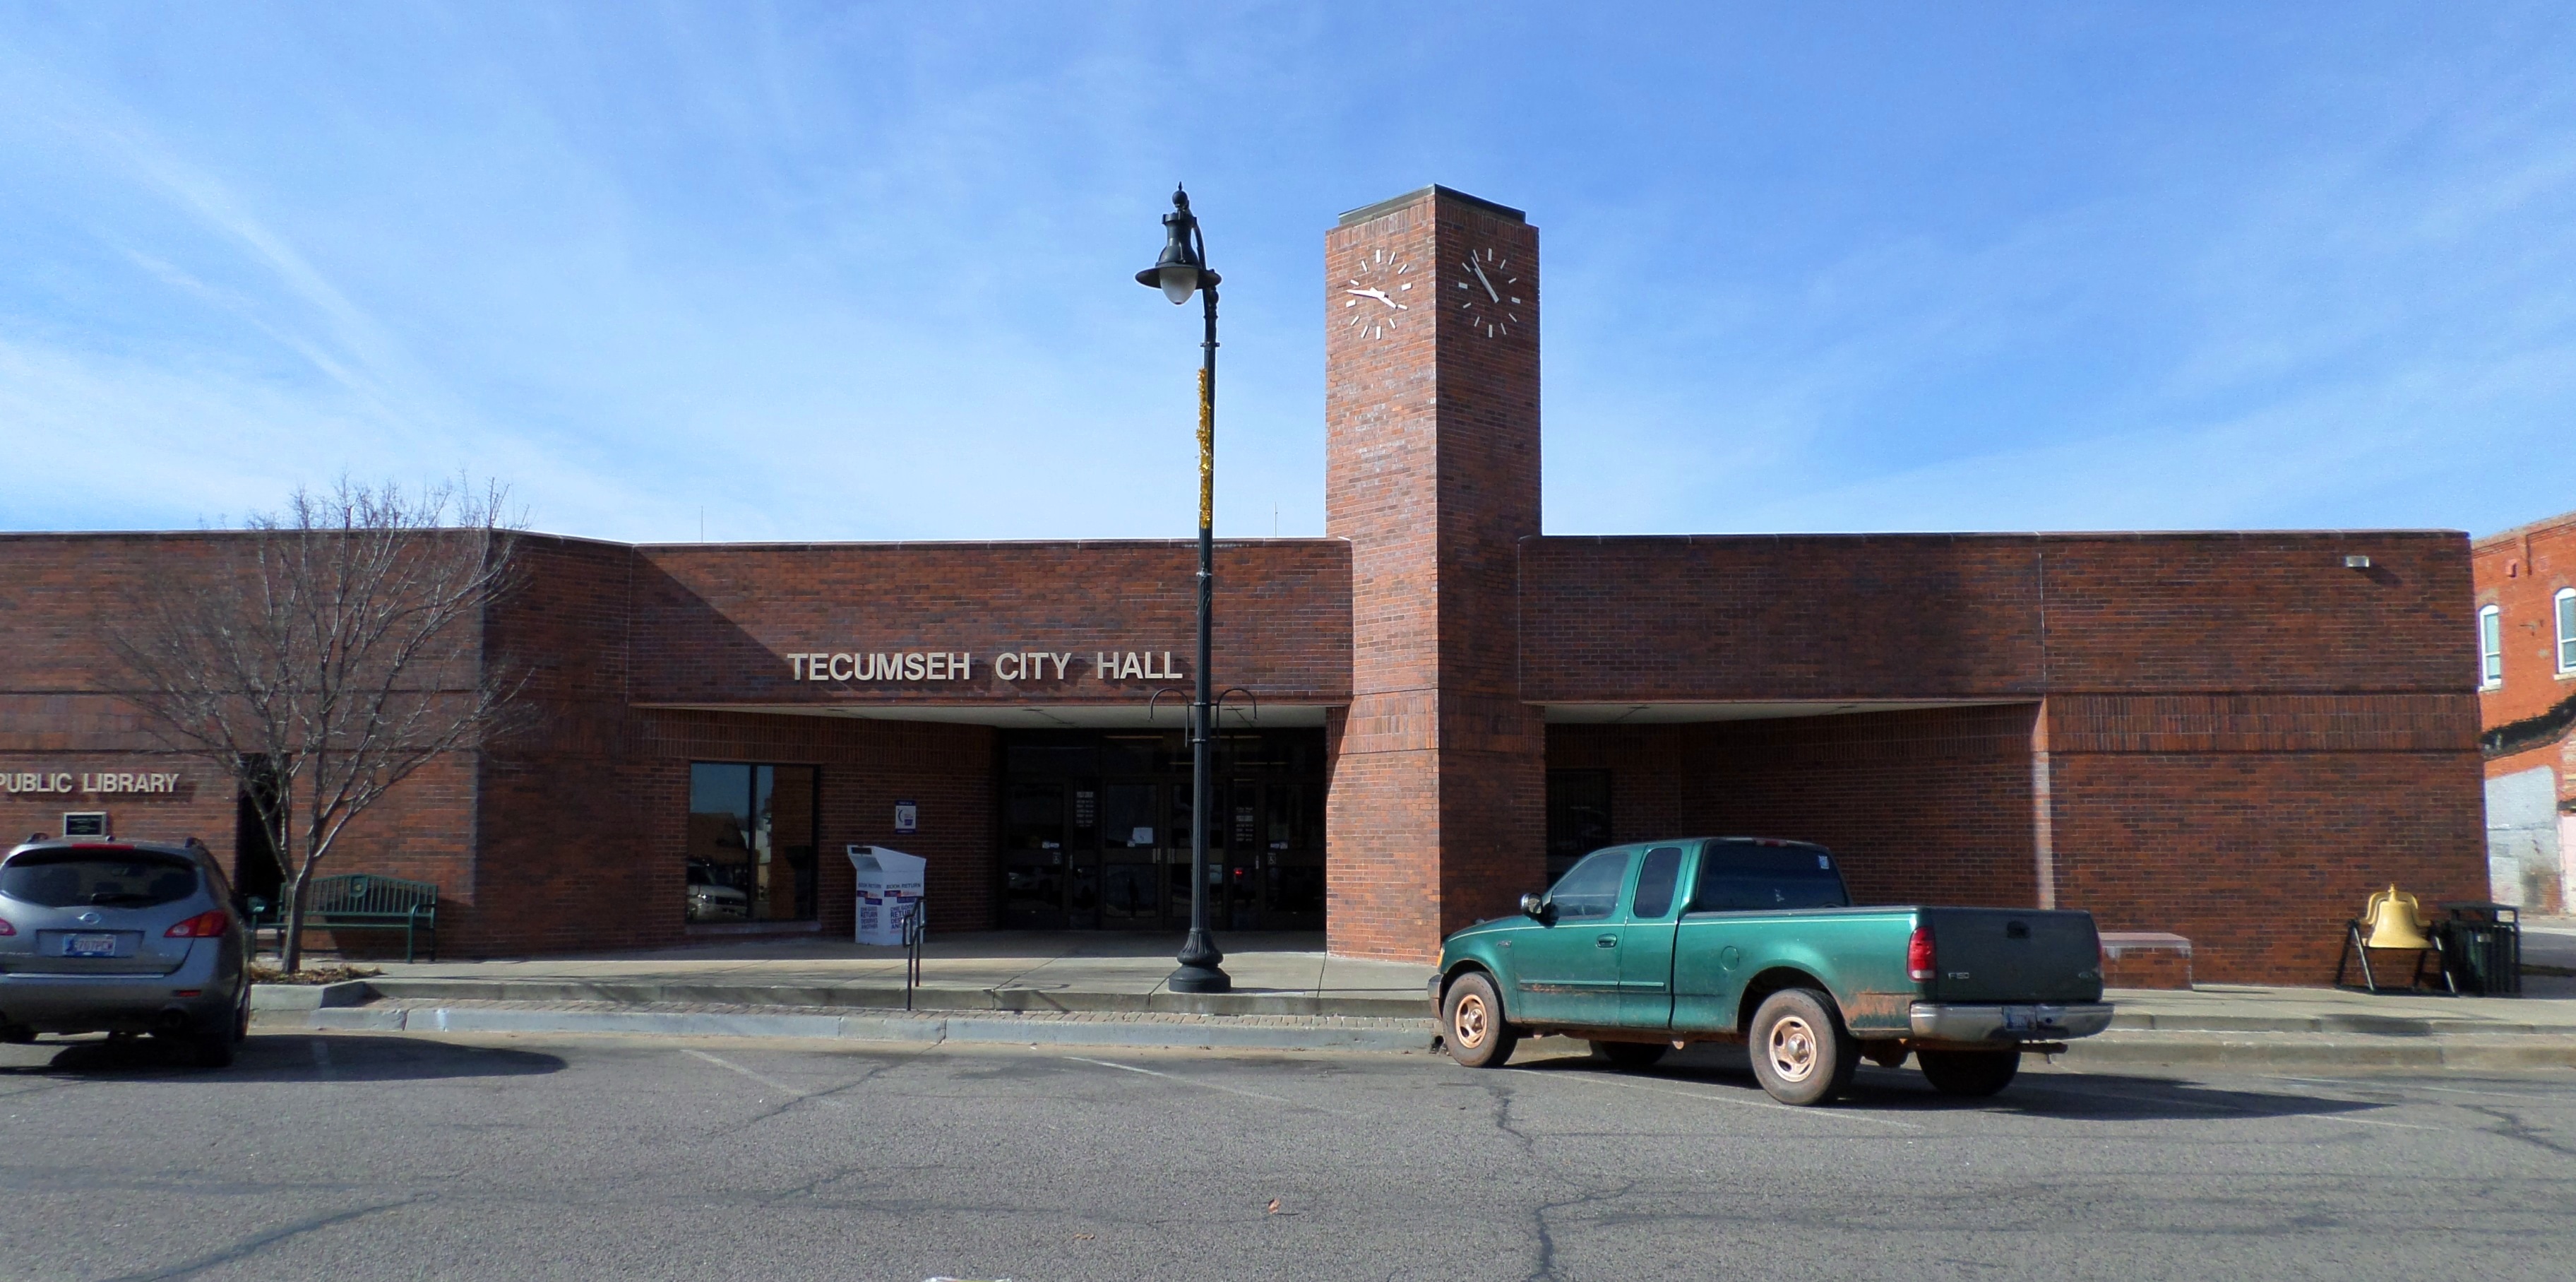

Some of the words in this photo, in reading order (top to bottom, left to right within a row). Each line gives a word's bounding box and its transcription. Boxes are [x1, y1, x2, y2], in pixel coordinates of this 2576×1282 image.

[787, 653, 970, 681] TECUMSEH
[995, 652, 1071, 680] CITY
[1097, 651, 1183, 679] HALL
[83, 773, 179, 793] LIBRARY
